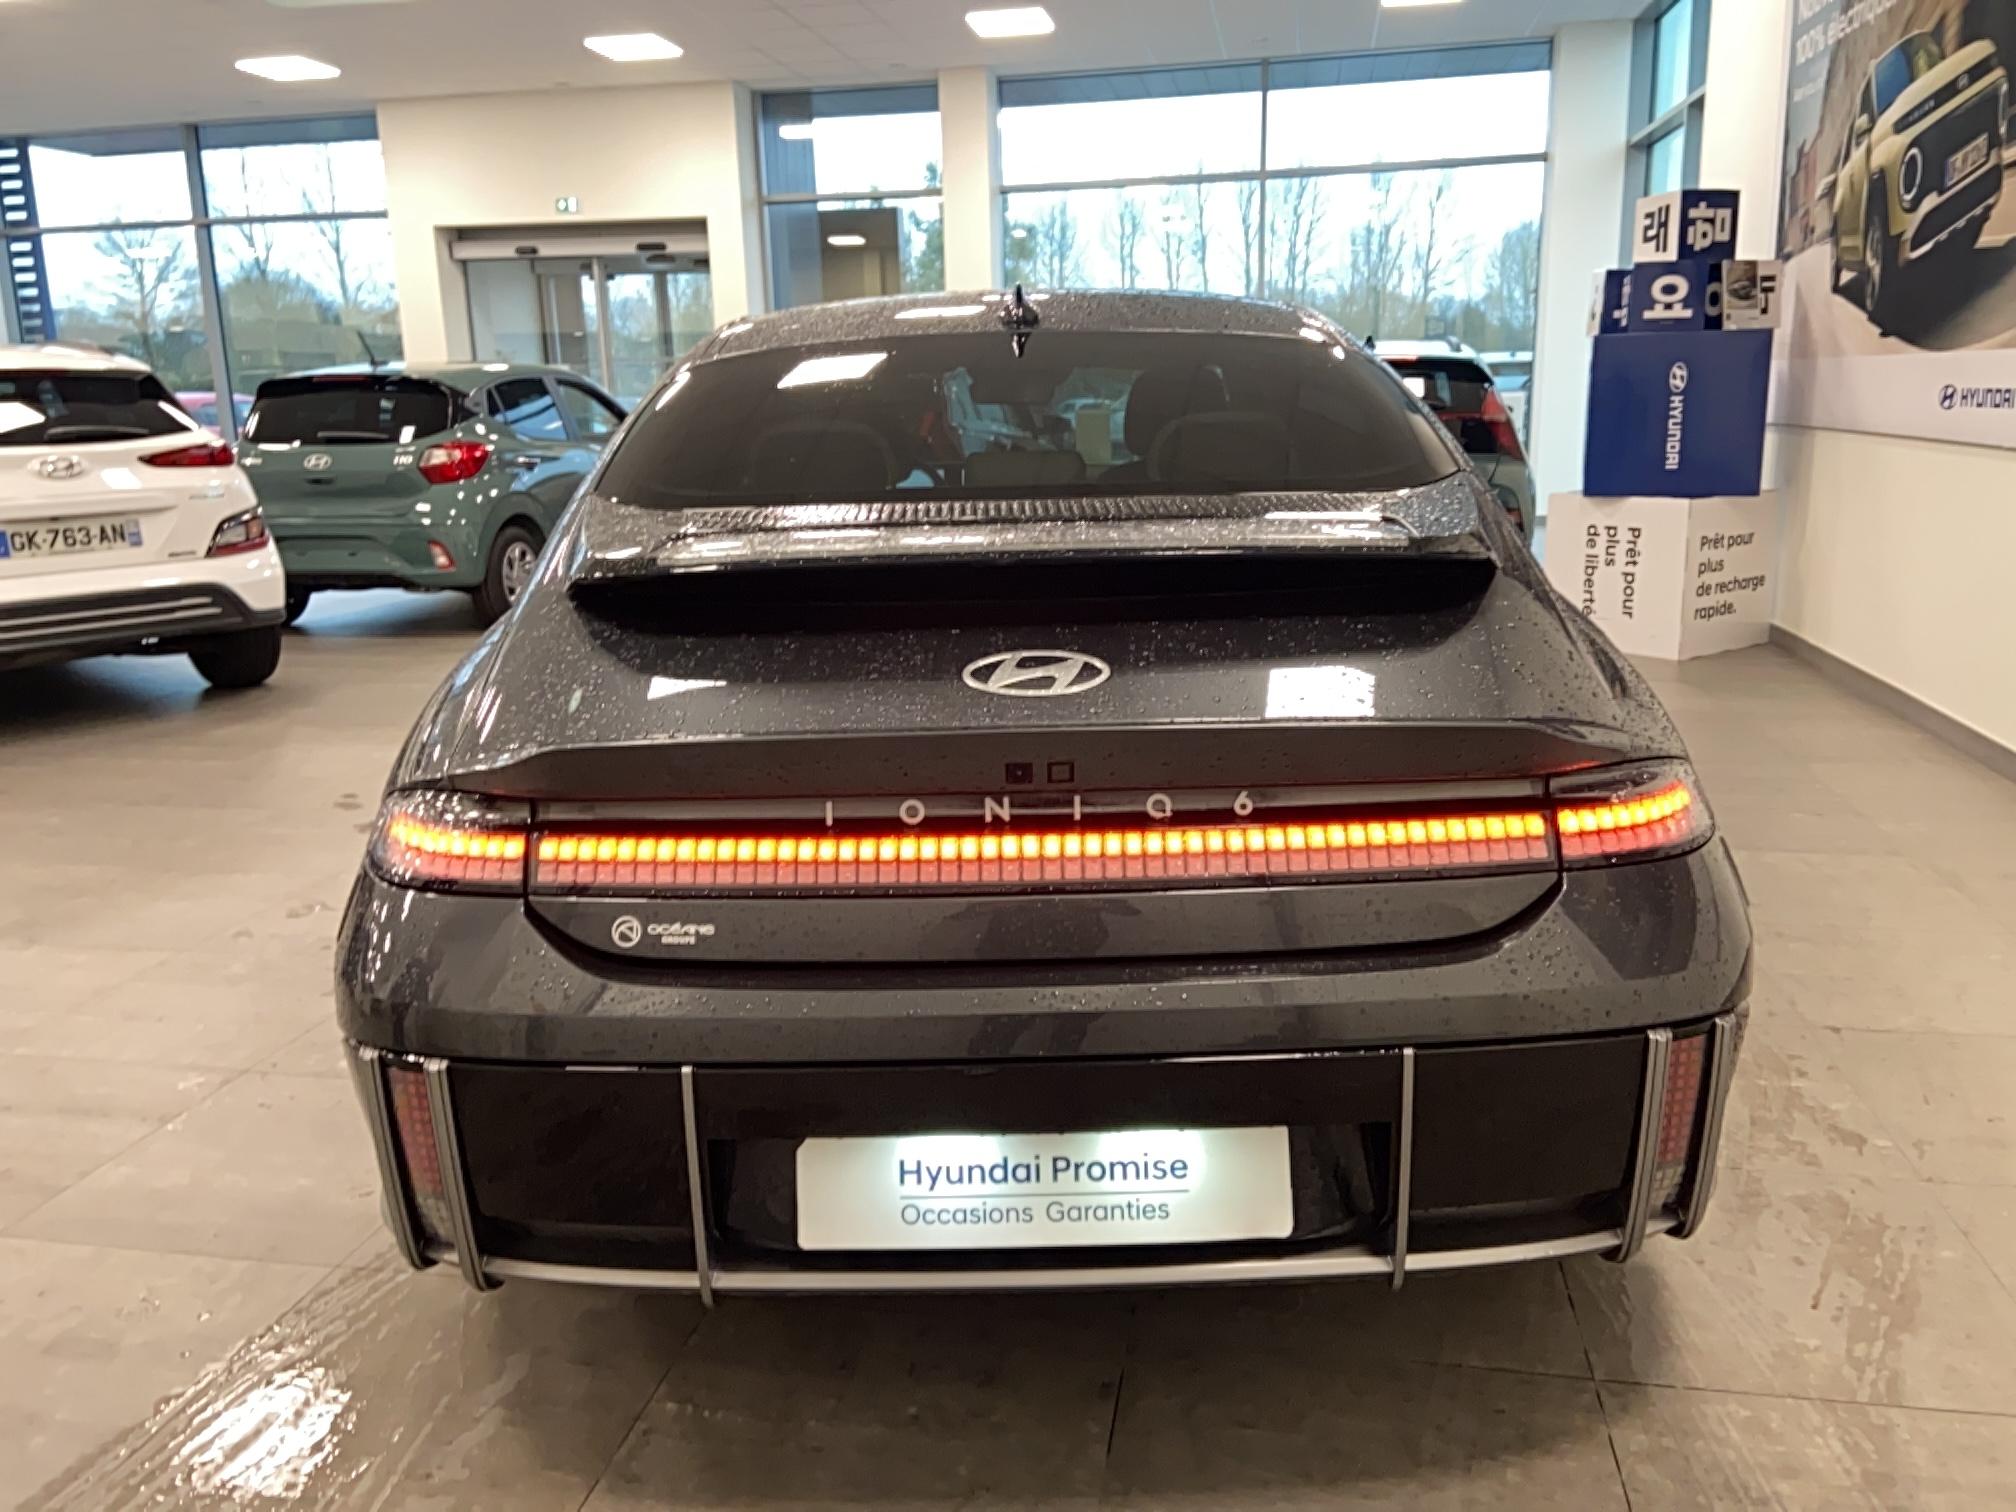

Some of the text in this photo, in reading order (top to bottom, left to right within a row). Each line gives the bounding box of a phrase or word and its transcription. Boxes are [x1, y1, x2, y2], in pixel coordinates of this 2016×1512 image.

[1642, 273, 1694, 320] 요
[1960, 387, 2016, 409] HYUNDAI
[1664, 395, 1685, 470] HYUNDAI
[1586, 524, 1600, 548] de
[1604, 525, 1620, 567] plus
[1700, 532, 1755, 552] Prêt pour
[1622, 527, 1642, 619] Prêt pour
[1698, 558, 1725, 577] plus
[1696, 574, 1766, 597] de recharge
[1694, 600, 1737, 622] rapide.
[899, 1151, 1189, 1191] Hyundai Promise
[900, 1197, 1170, 1226] Occasions Garanties
